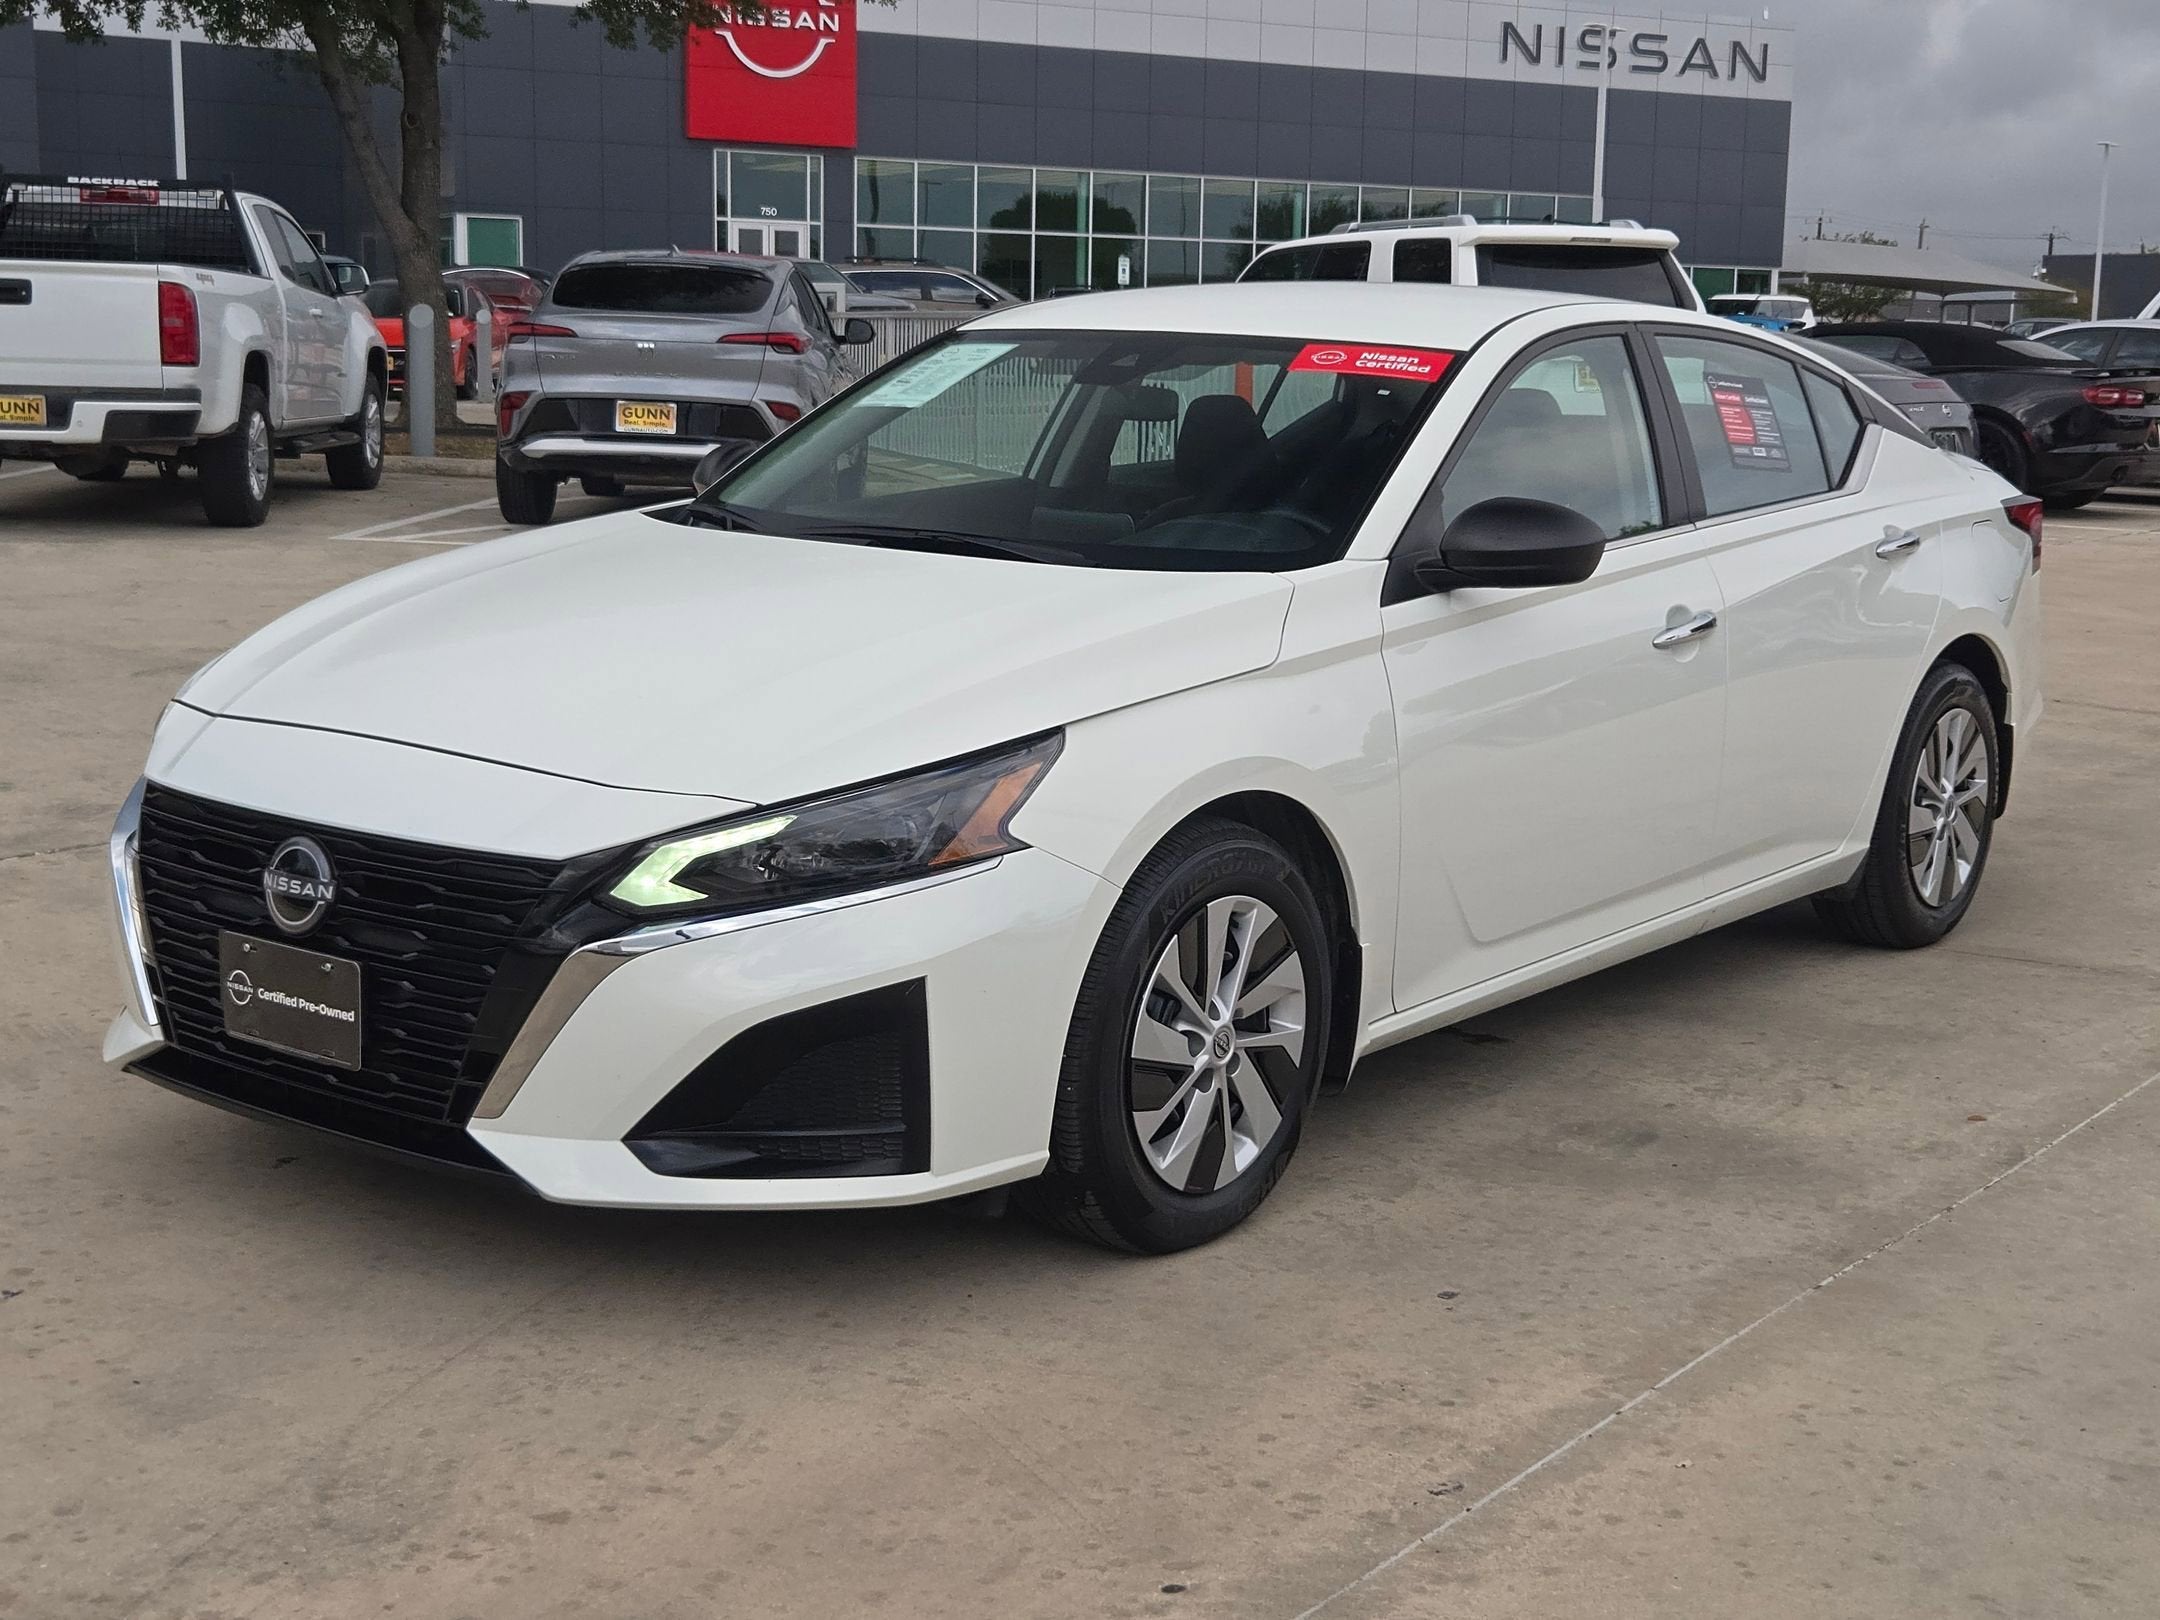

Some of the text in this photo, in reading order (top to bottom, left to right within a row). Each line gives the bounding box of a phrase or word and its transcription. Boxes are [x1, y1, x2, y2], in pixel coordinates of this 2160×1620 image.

[1501, 21, 1769, 83] NISSAN
[67, 176, 160, 187] BACKRACK
[760, 207, 778, 217] 750
[1360, 352, 1420, 364] Nissan
[1355, 360, 1432, 373] Certified
[0, 401, 40, 415] UNN
[622, 407, 671, 420] GUNN
[264, 871, 333, 899] NISSAN
[227, 981, 253, 994] NISSAN
[258, 988, 355, 1022] Certified Pre-Owned
